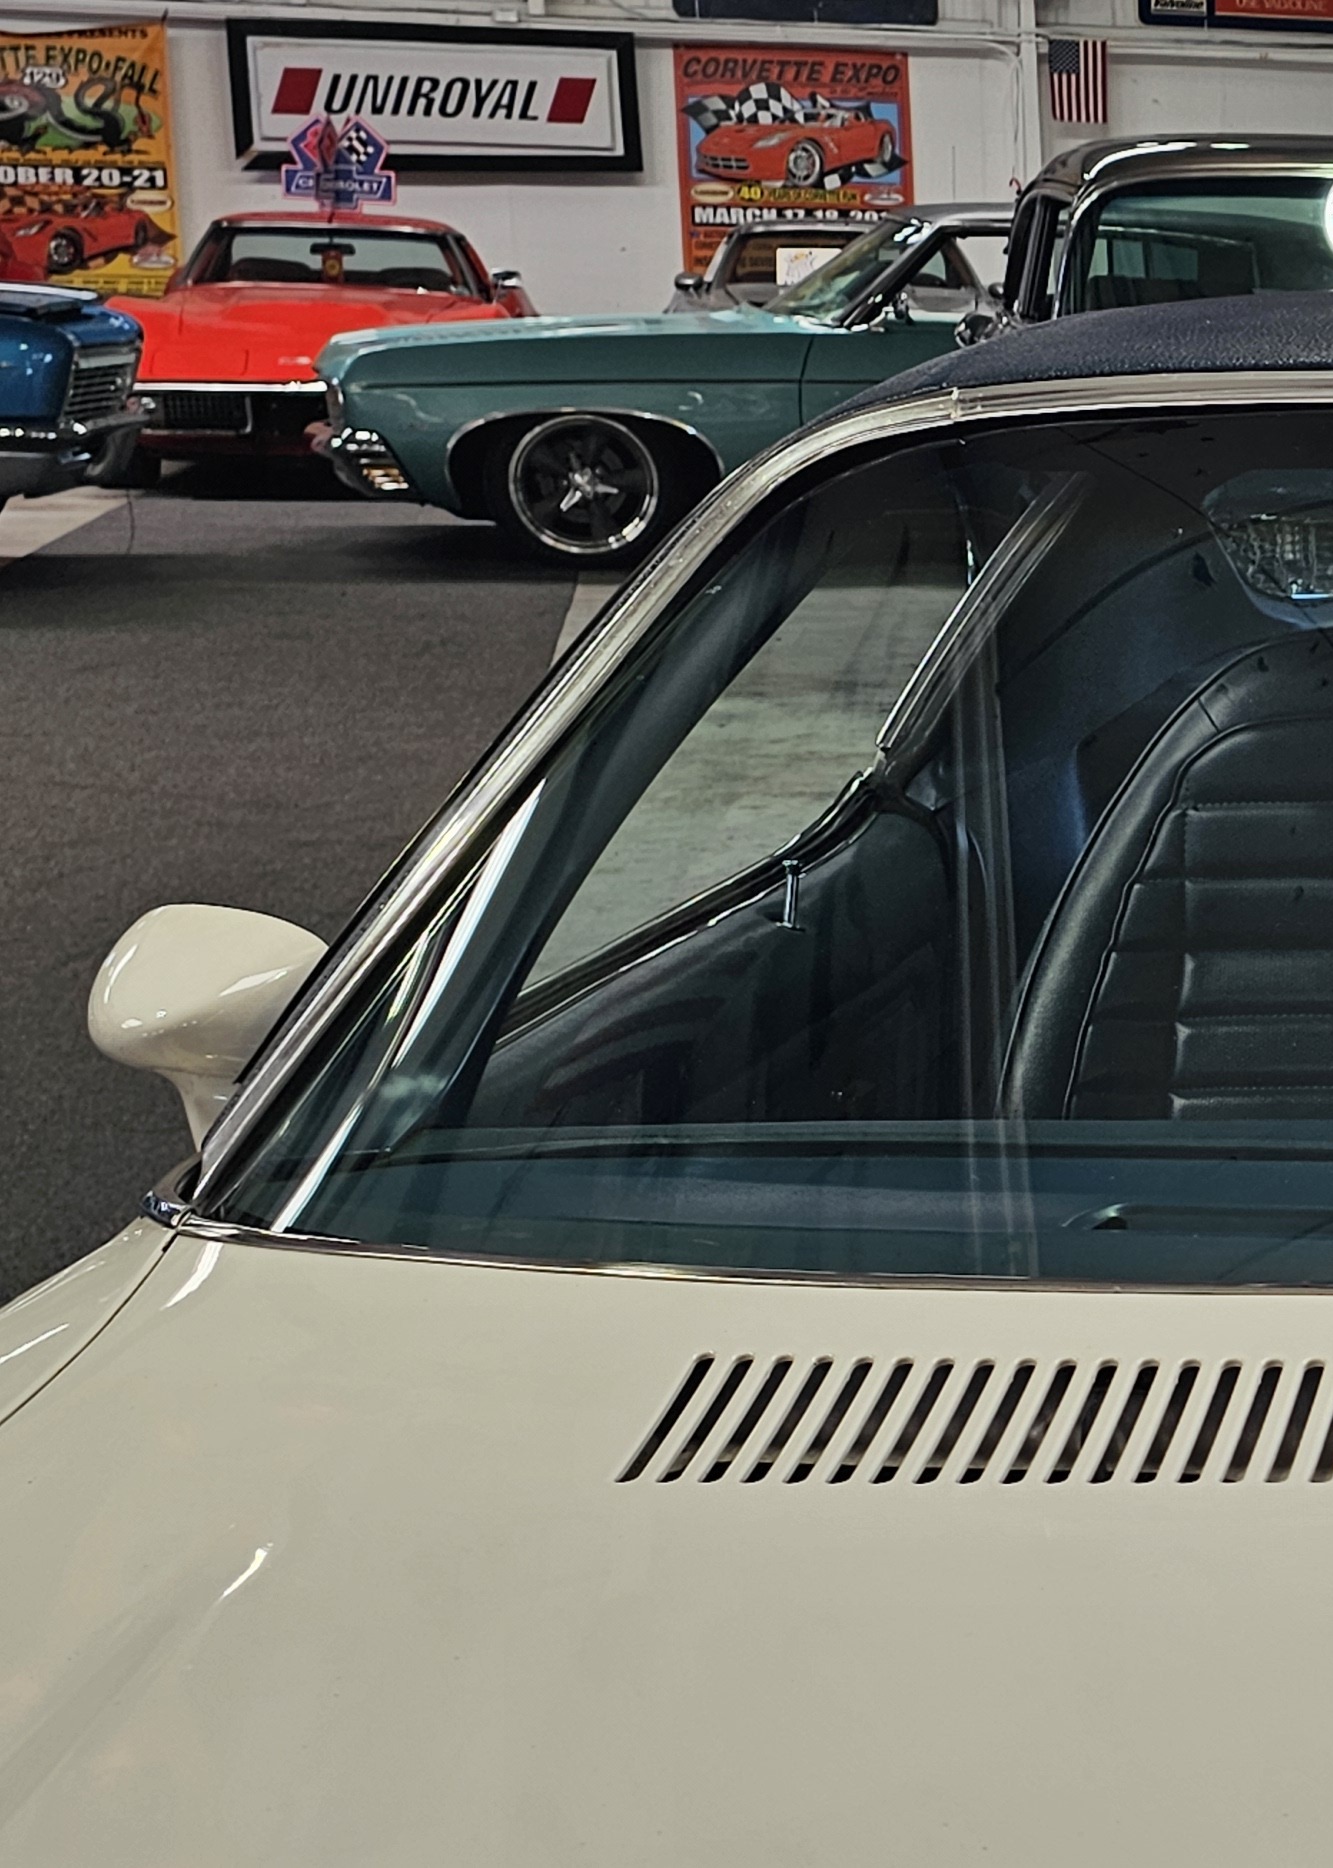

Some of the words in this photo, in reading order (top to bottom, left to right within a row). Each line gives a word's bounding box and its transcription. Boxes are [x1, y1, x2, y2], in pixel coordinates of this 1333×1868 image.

[682, 56, 824, 83] CORVETTE
[829, 59, 901, 86] EXPO
[323, 73, 540, 121] UNIROYAL
[81, 167, 166, 188] 20-21
[297, 178, 380, 193] CHROLET
[740, 185, 761, 200] 40
[694, 205, 778, 225] MARCH
